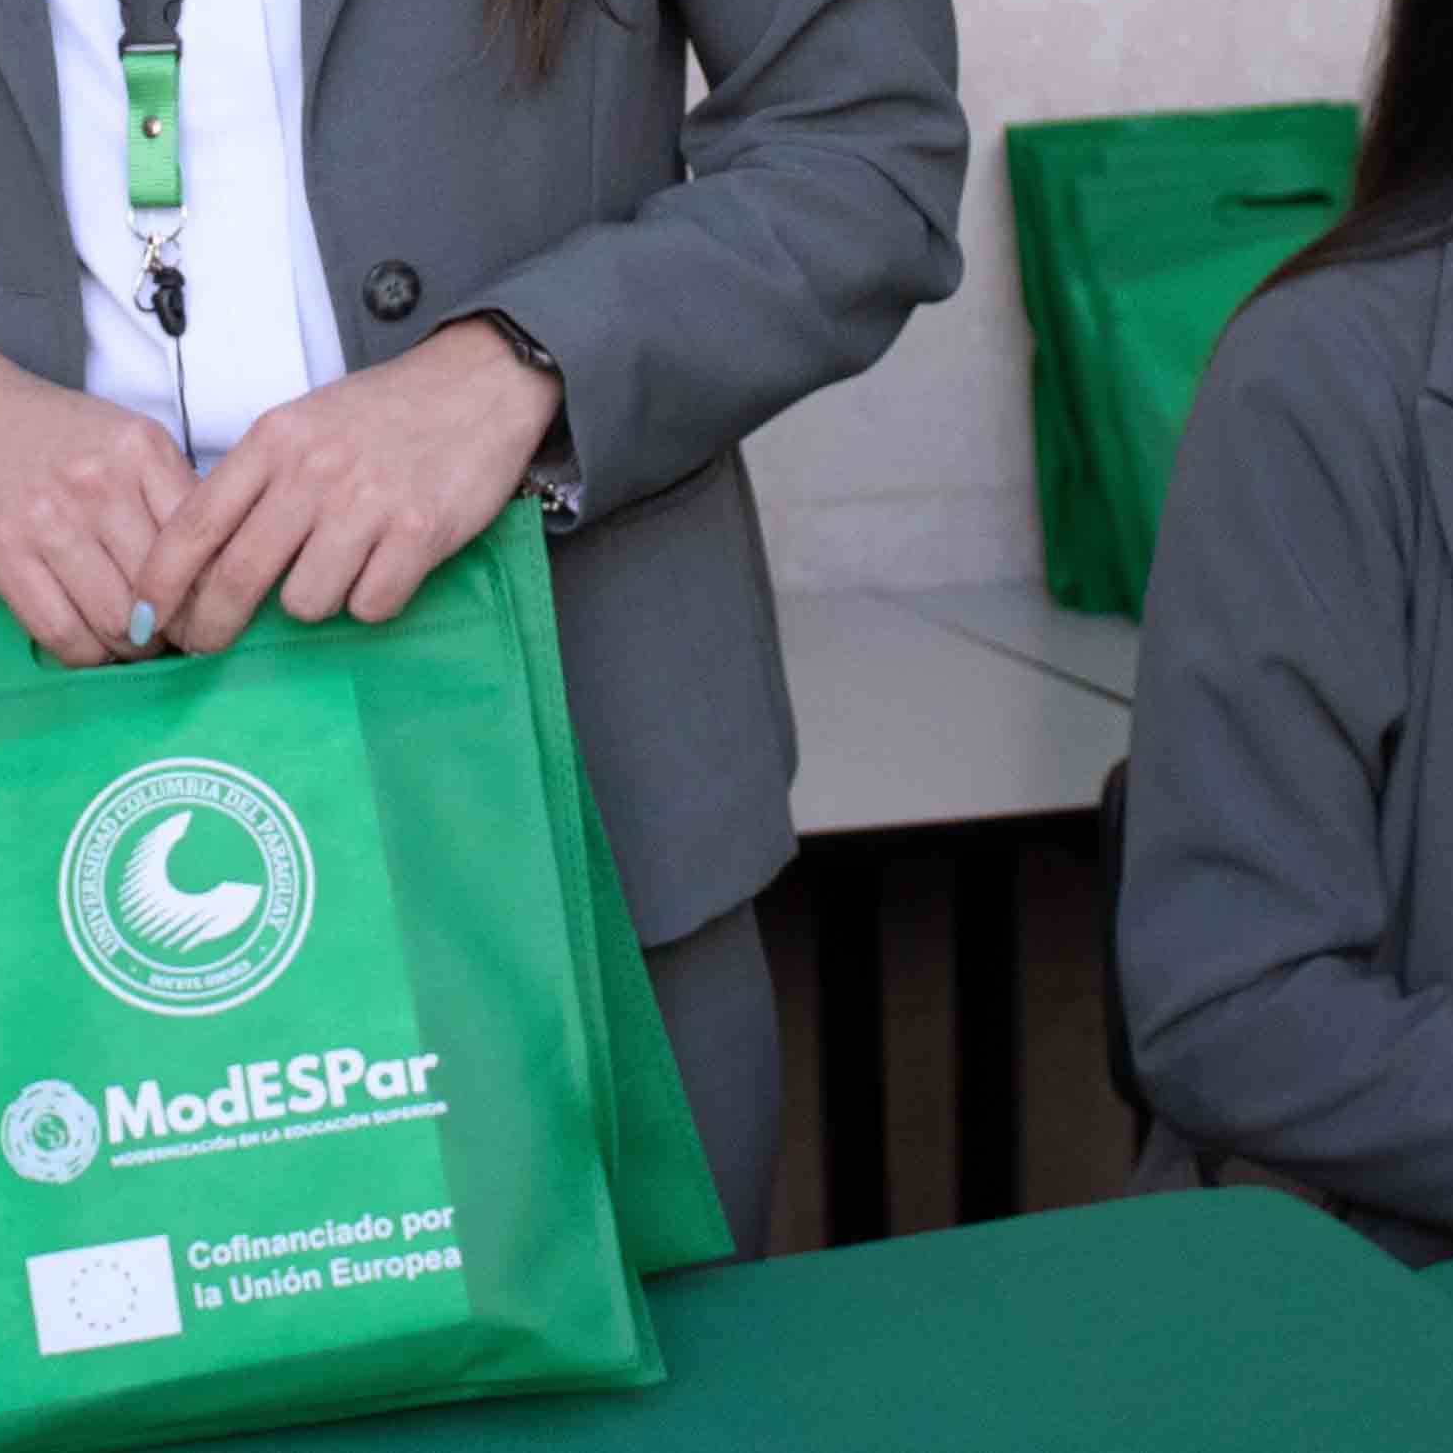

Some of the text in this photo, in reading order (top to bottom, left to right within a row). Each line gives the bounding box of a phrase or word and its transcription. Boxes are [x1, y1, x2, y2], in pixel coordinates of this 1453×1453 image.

[82, 777, 295, 959] UNIVERSIDAD COLUMBIA DEL PARAGUAY
[105, 1047, 439, 1145] ModESPar
[187, 1205, 455, 1270] Cofinanciado por
[193, 1244, 463, 1309] la Unión Europea
